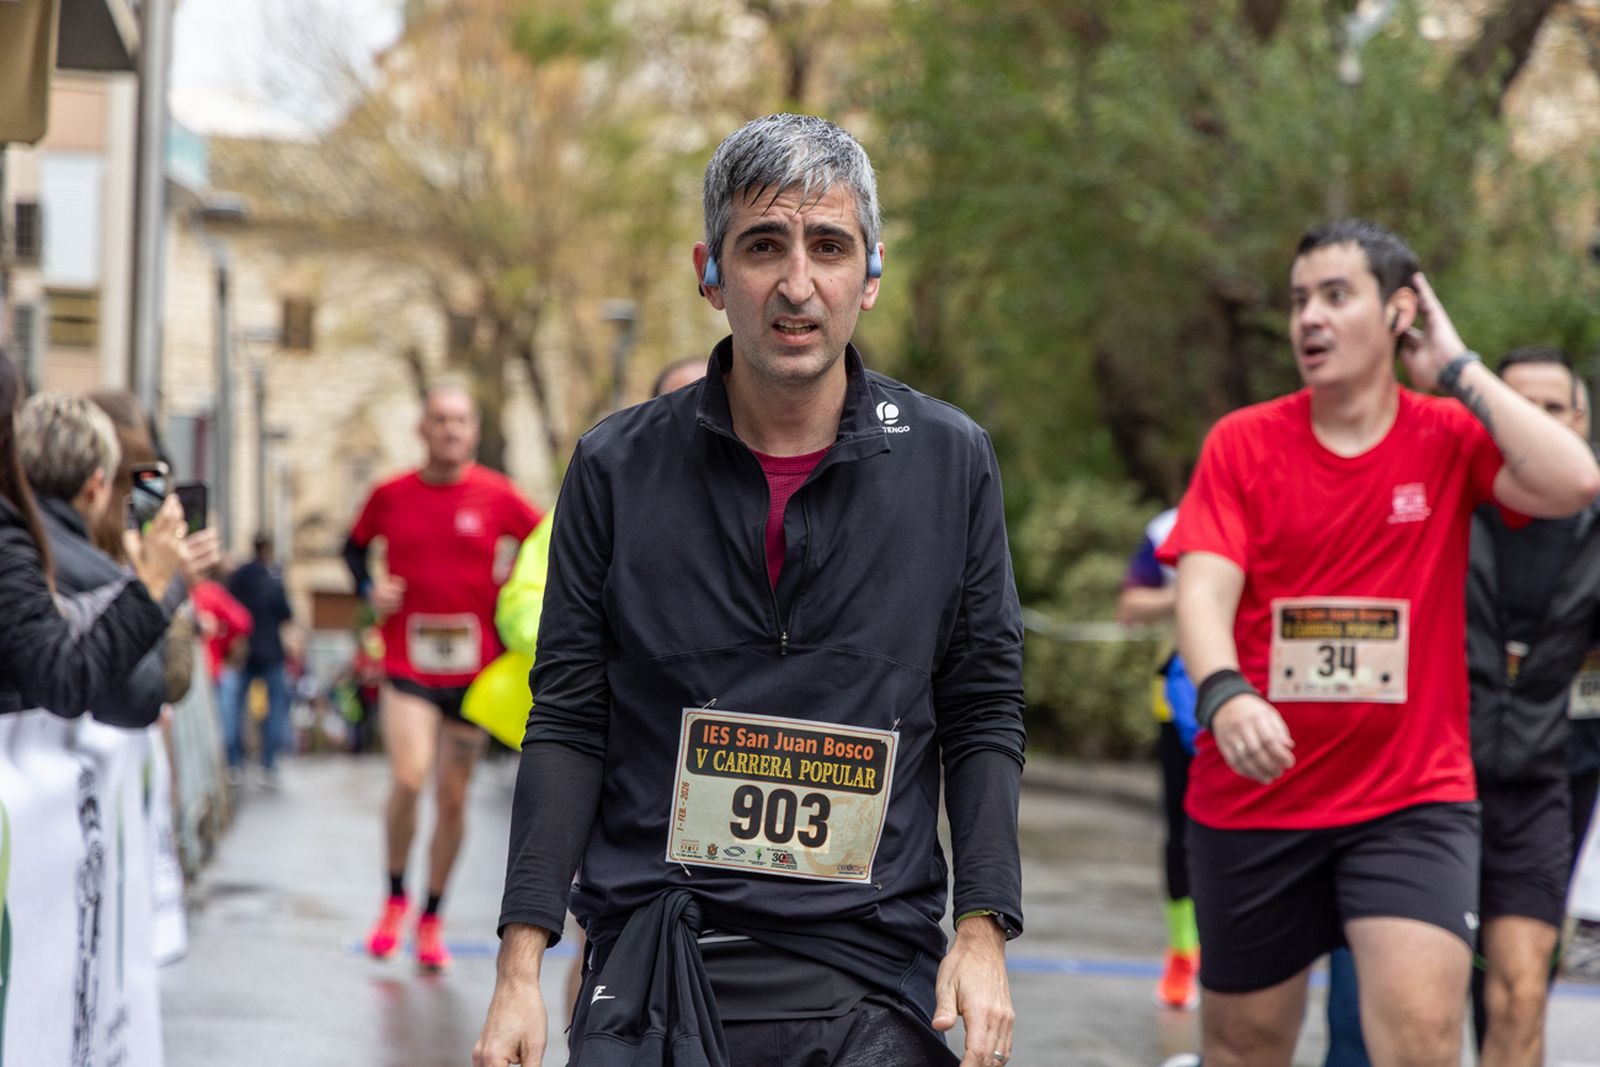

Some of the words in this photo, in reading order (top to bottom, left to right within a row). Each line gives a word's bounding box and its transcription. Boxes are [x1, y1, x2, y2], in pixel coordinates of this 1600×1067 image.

[1318, 645, 1356, 677] 34
[703, 725, 731, 746] IES
[736, 727, 769, 749] San
[774, 732, 817, 755] Juan
[823, 736, 874, 761] Bosco
[696, 748, 709, 769] V
[713, 750, 792, 779] CARRERA
[799, 760, 876, 789] POPULAR
[680, 781, 689, 801] 2026
[730, 785, 831, 848] 903
